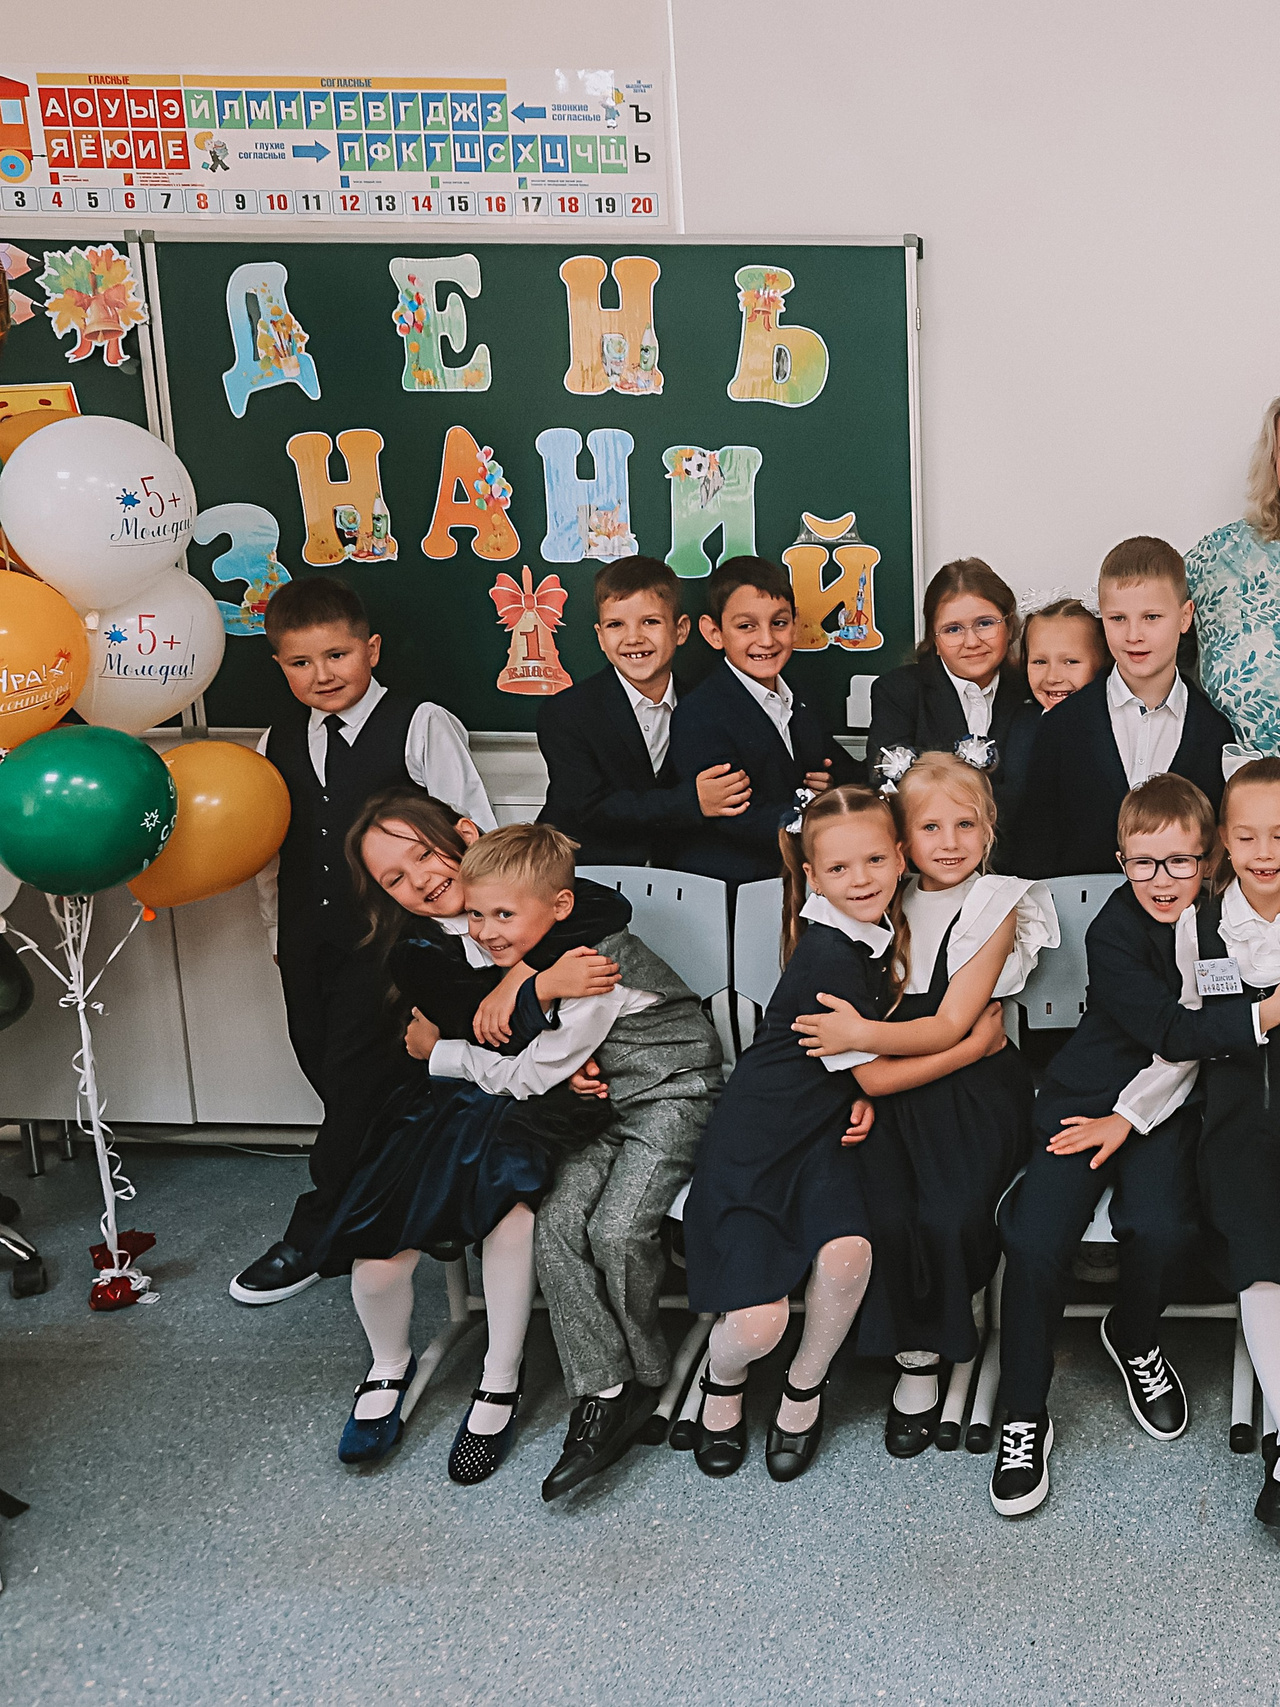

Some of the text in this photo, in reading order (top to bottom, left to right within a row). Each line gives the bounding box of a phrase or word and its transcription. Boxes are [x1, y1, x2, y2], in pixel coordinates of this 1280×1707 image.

[88, 75, 130, 85] ГЛАСНЫЕ
[320, 78, 372, 88] СОГЛАСНЫЕ
[552, 113, 601, 121] согласные
[255, 142, 285, 151] глухие
[14, 191, 653, 214] 3 4 5 6 7 8 9 10 11 12 13 14 15 16 17 18 19 20
[223, 254, 828, 417] ДЕНЬ
[140, 476, 181, 518] 5+
[110, 506, 192, 543] Молодец!
[138, 614, 181, 656] 5+
[520, 624, 546, 661] 1
[100, 653, 195, 686] Молодец!
